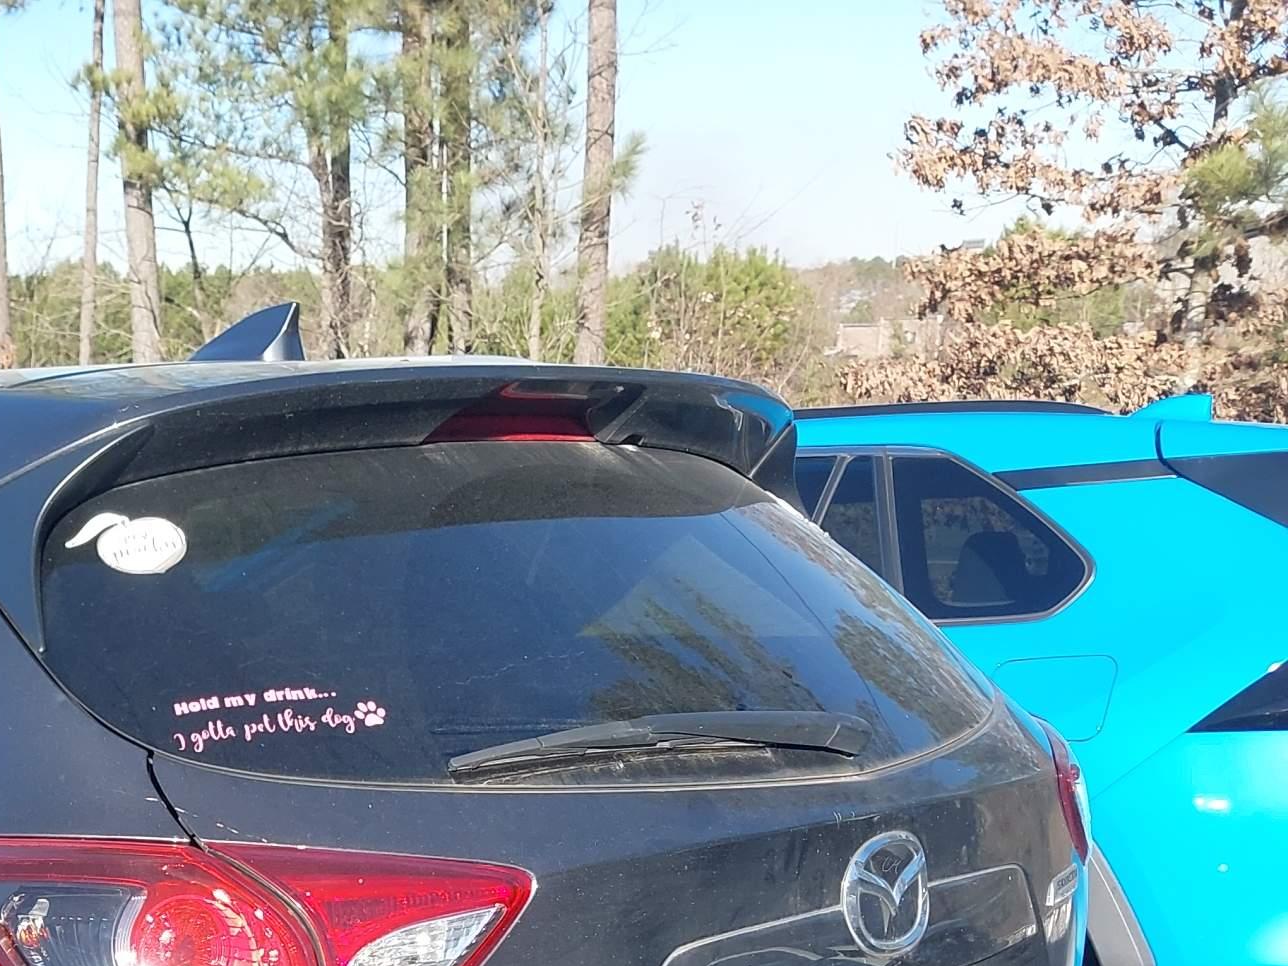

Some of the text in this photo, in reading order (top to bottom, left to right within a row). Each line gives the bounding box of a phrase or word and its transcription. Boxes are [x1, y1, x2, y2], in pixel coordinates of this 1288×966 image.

[173, 687, 337, 715] Hold my drink...
[173, 733, 186, 751] I
[191, 719, 236, 752] gotta
[244, 713, 276, 742] pet
[277, 708, 317, 733] this
